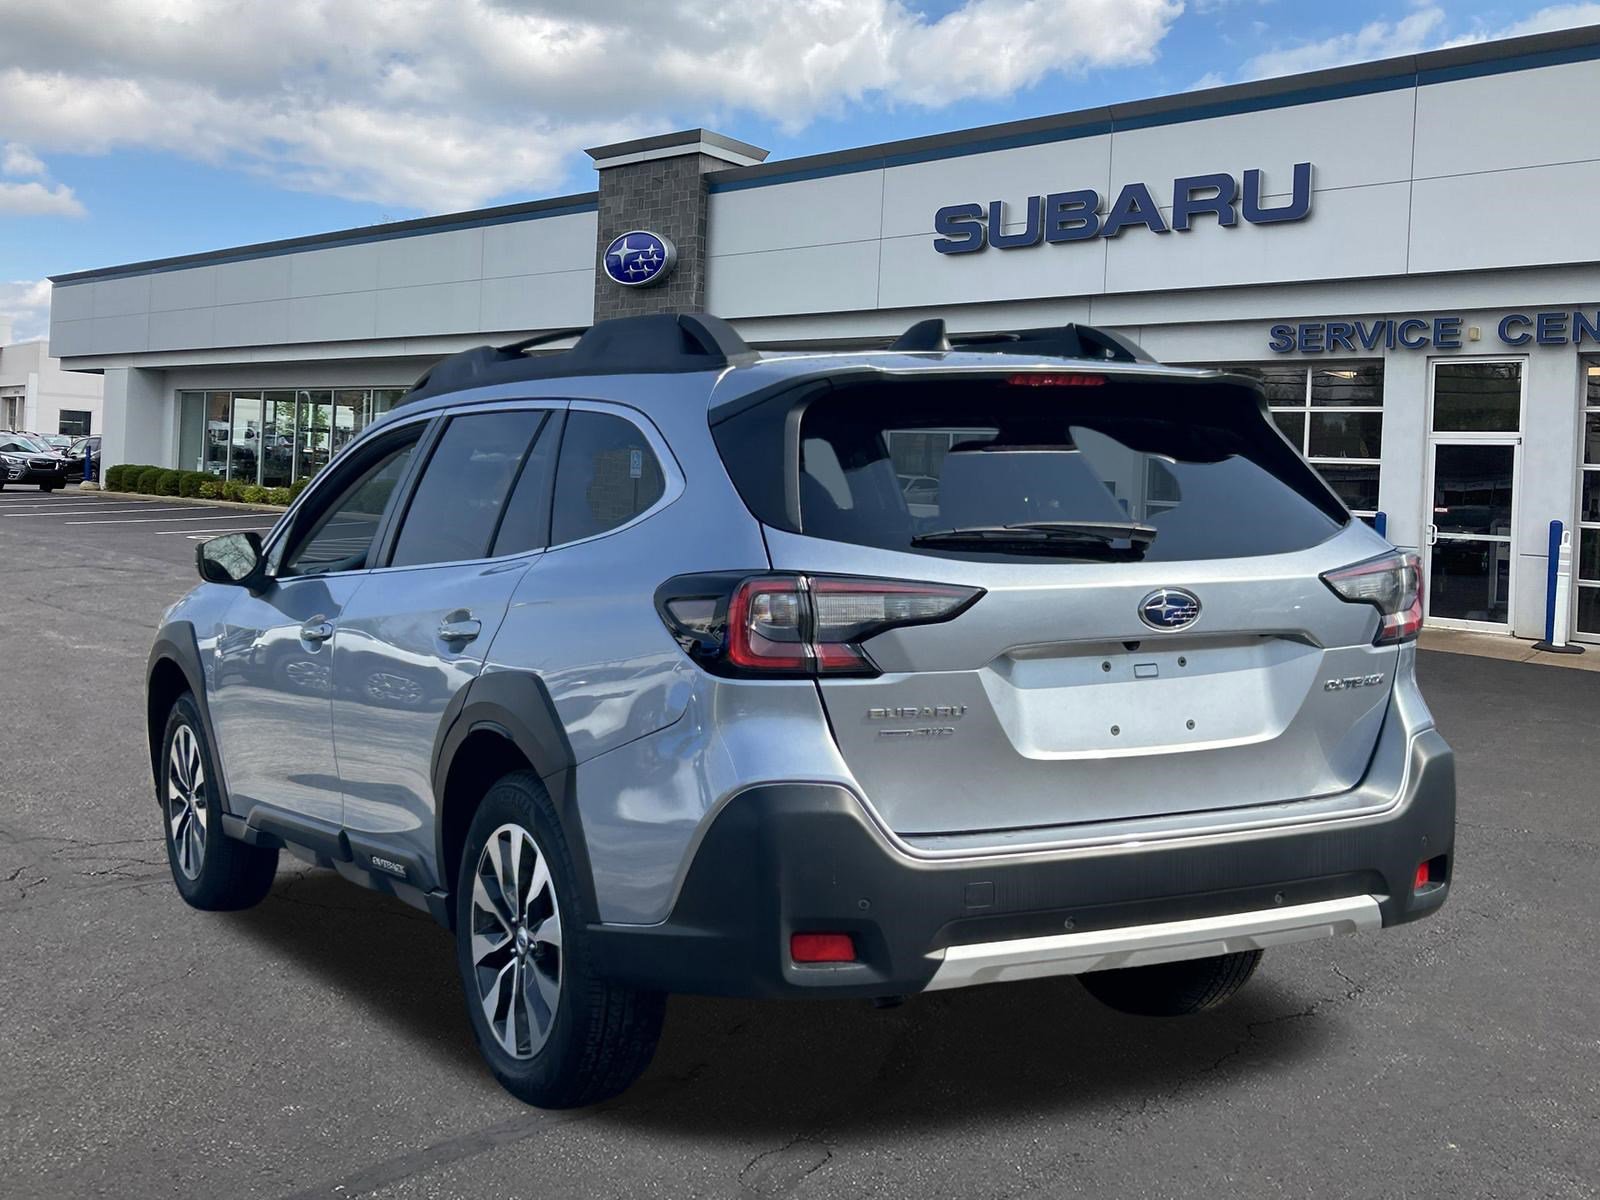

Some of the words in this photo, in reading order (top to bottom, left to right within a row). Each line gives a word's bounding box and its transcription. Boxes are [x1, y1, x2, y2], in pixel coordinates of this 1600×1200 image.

[934, 162, 1313, 254] SUBARU
[1269, 317, 1463, 353] SERVICE
[1497, 311, 1600, 346] CEN
[1325, 673, 1384, 690] OUTBACK
[868, 705, 967, 721] SUBARU
[372, 856, 406, 876] OUTBACK
